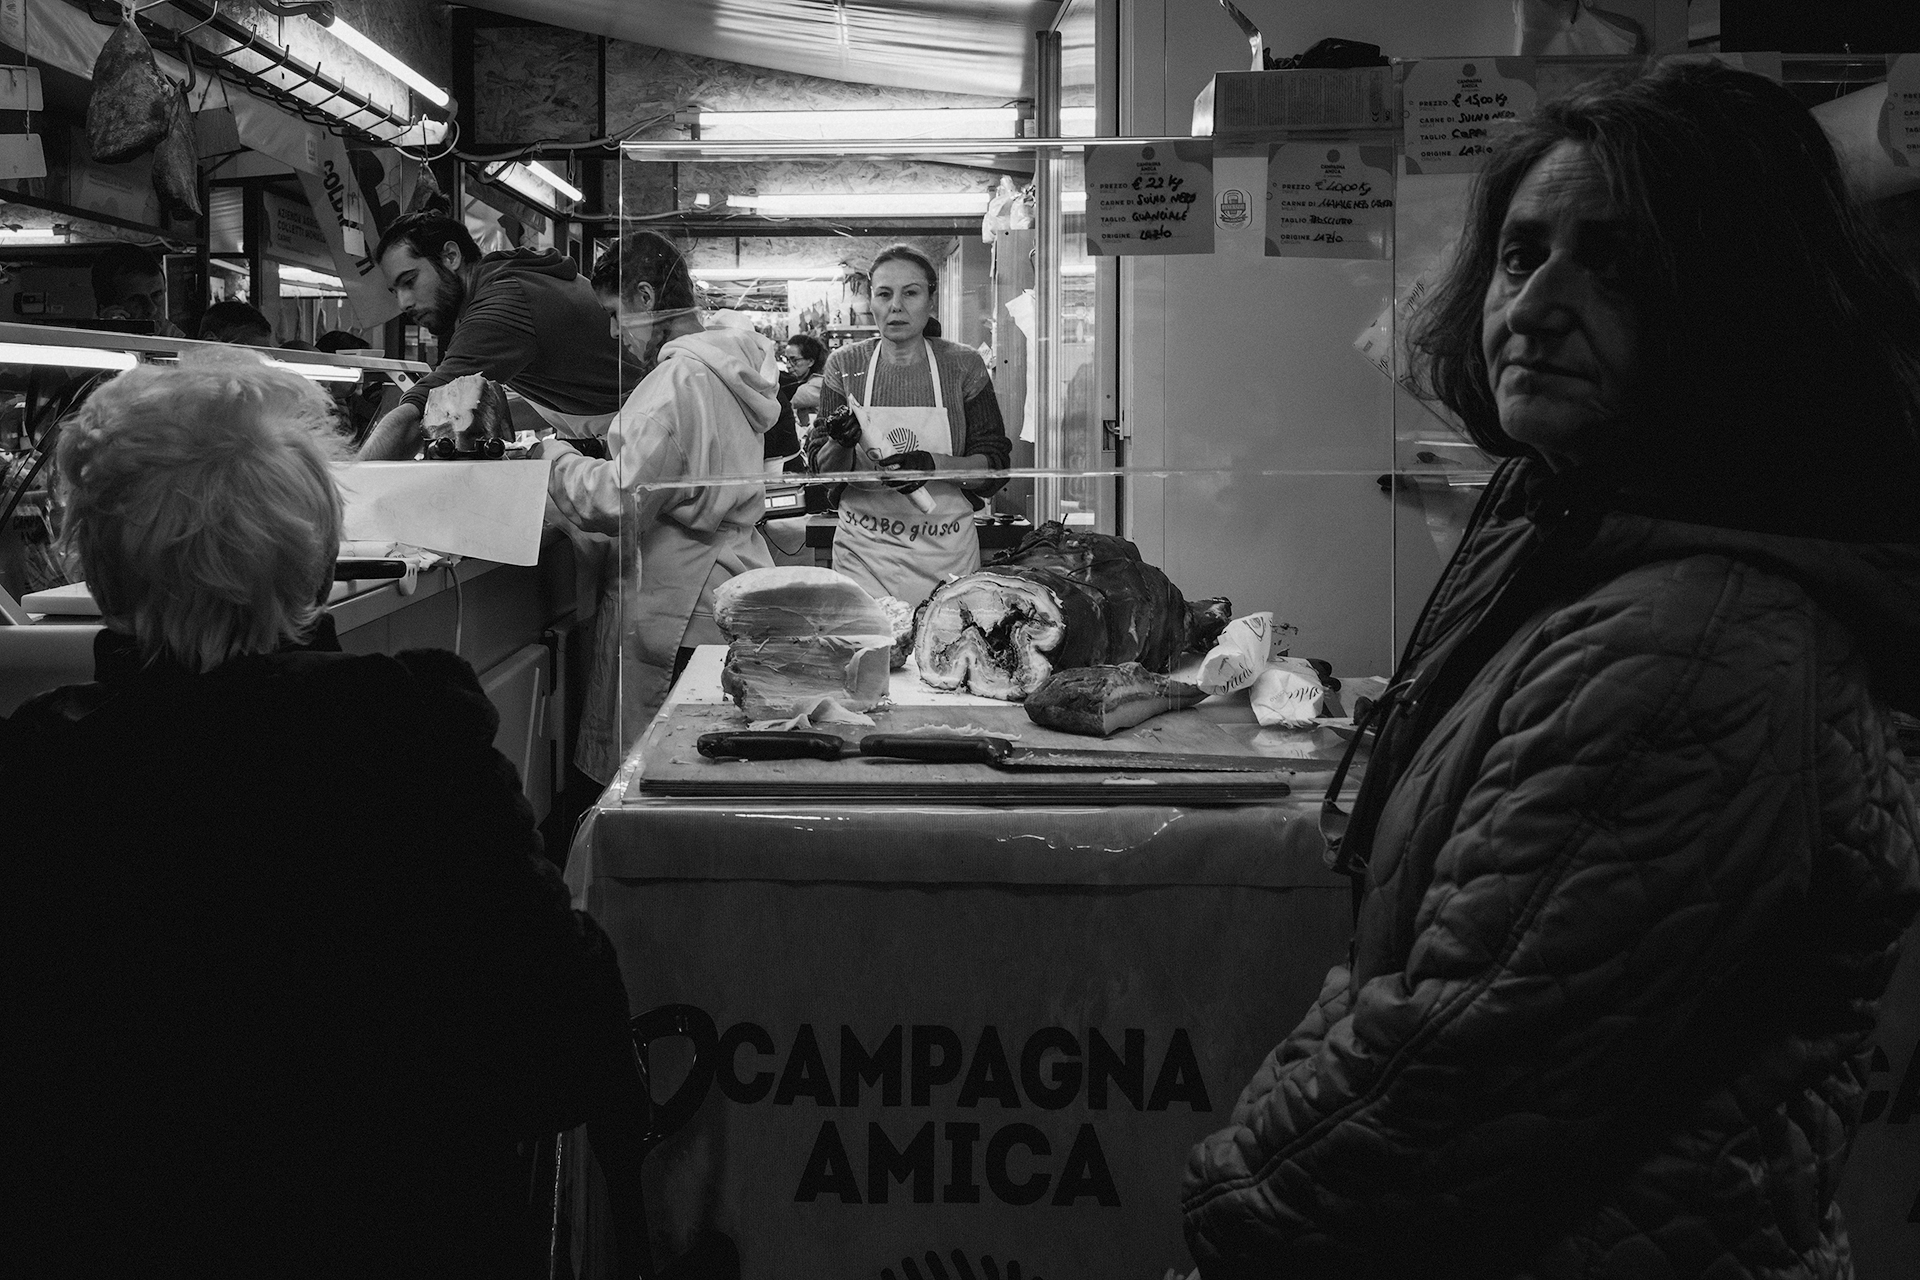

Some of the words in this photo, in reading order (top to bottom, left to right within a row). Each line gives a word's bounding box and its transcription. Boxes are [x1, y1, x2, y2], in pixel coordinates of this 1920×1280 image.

[1145, 177, 1164, 189] 22
[717, 1021, 1213, 1112] CAMPAGNA
[794, 1120, 1122, 1208] AMICA
